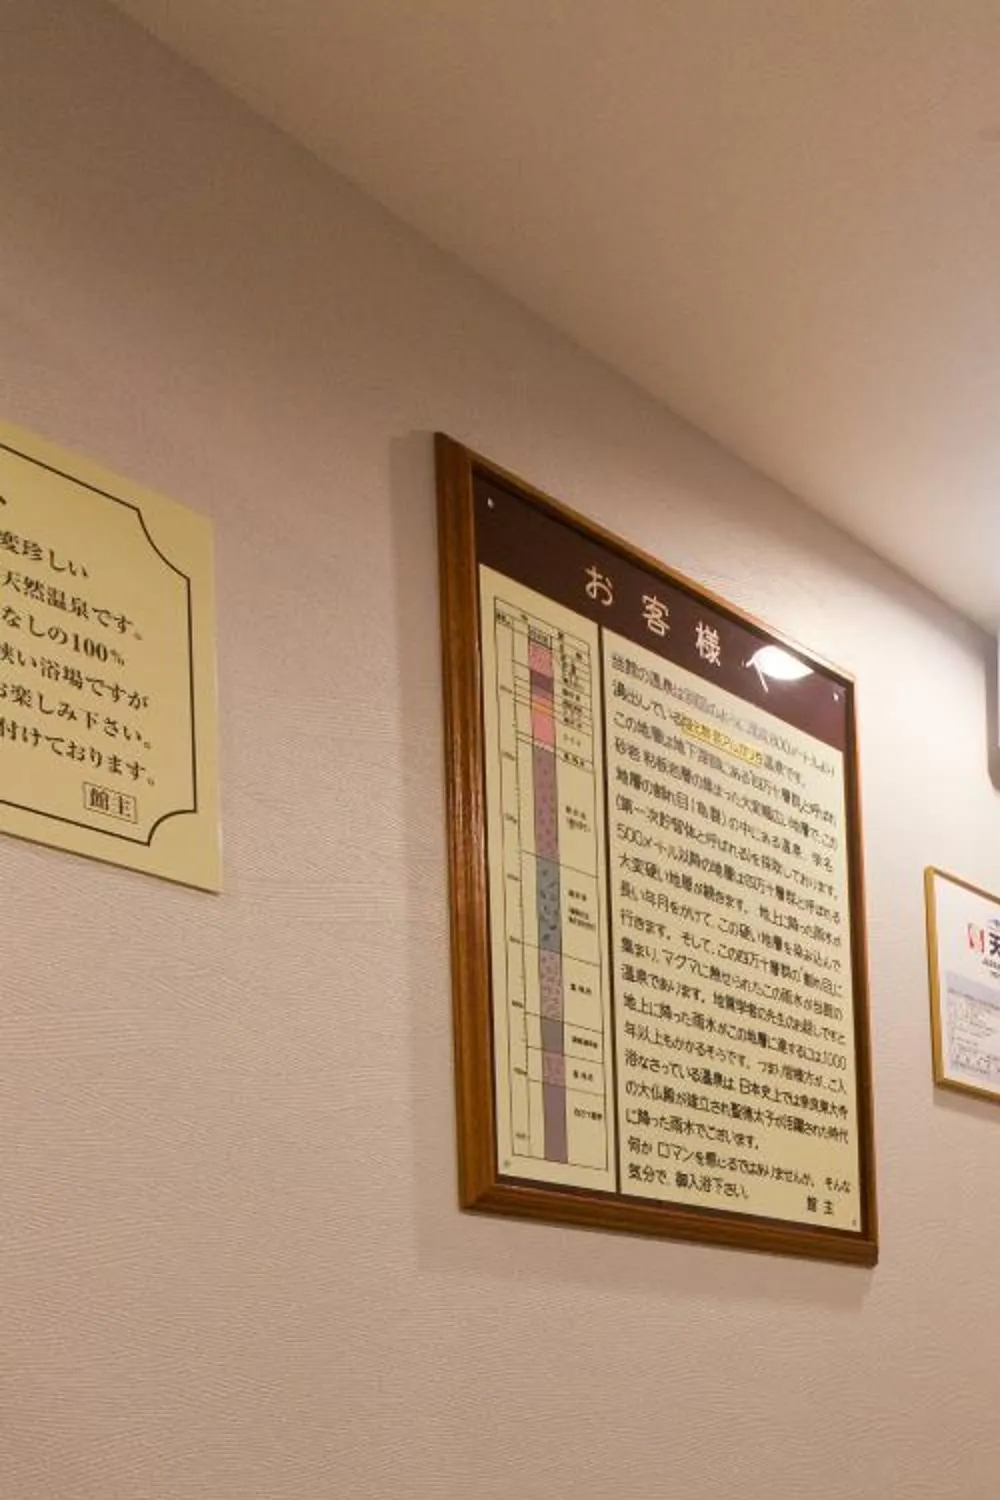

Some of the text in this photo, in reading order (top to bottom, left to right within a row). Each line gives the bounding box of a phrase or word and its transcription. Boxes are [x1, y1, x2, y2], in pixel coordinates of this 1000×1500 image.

[2, 570, 143, 641] 天然温泉です。
